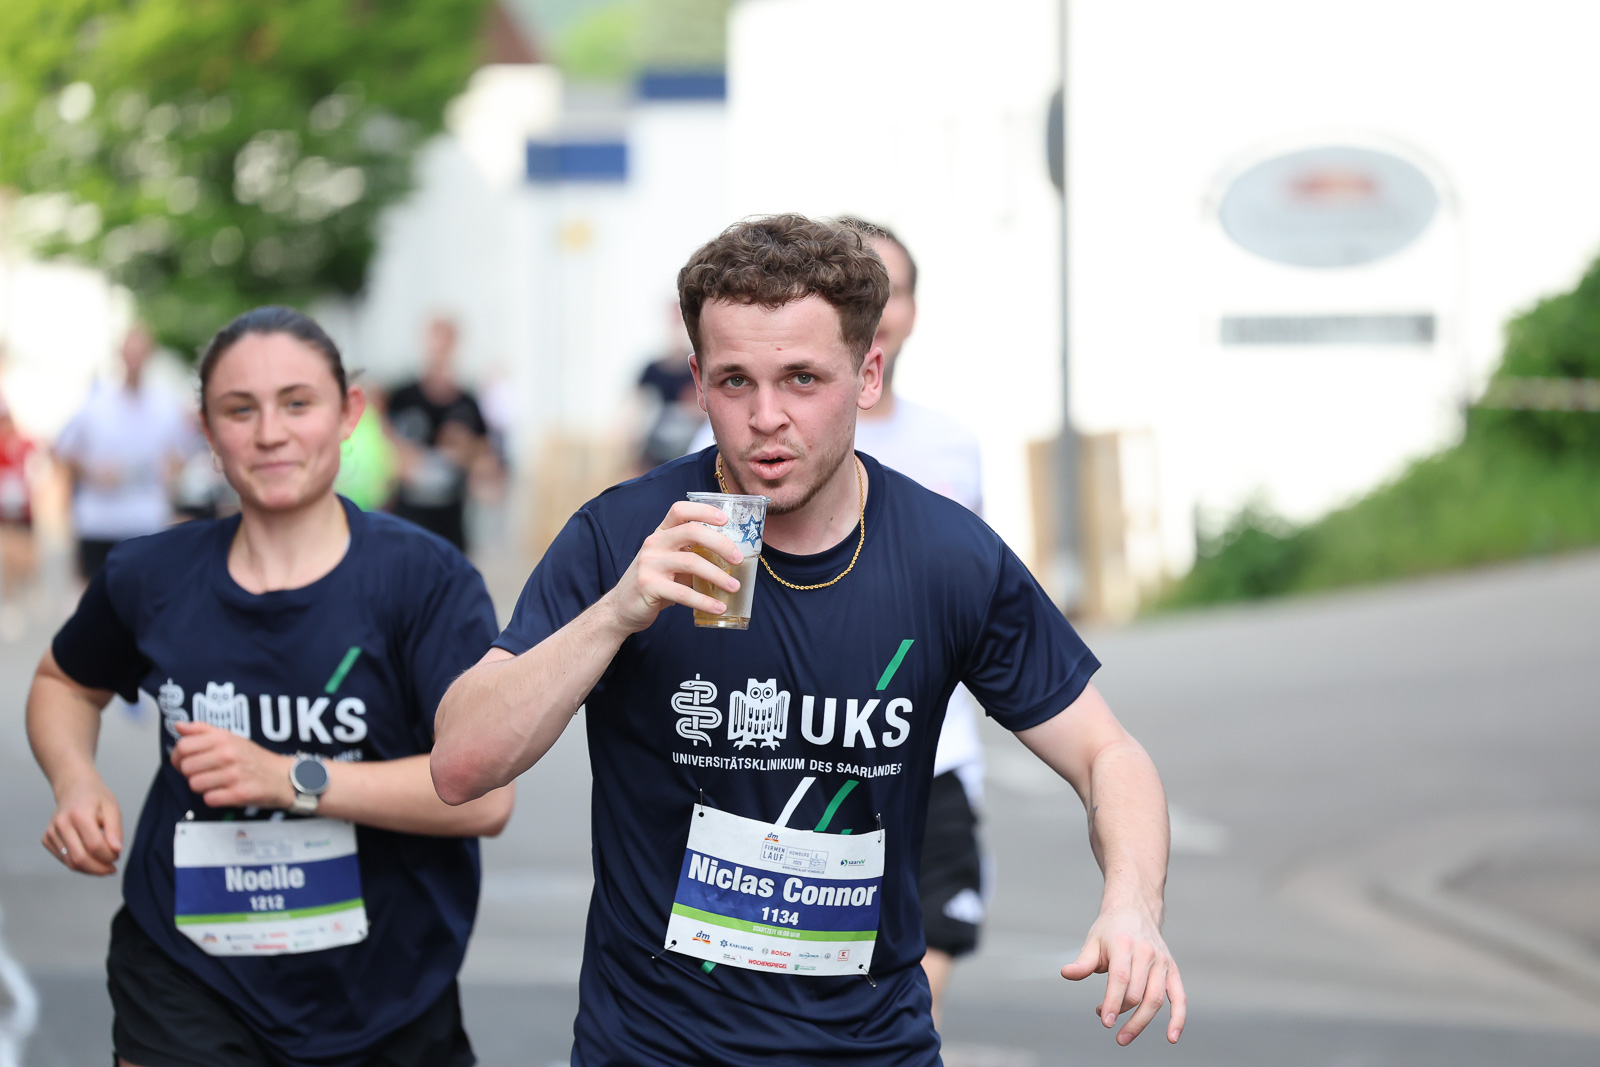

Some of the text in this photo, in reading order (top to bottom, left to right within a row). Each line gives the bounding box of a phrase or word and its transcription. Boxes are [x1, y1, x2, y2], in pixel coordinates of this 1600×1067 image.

[259, 694, 368, 744] UKS
[800, 695, 913, 748] UKS
[672, 751, 902, 778] UNIVERSITÄTSKLINIKUM DES SAARLANDES
[767, 832, 779, 840] dm
[764, 844, 785, 853] FIRMEN
[763, 852, 784, 861] LAUF
[225, 864, 305, 892] Noelle
[688, 853, 877, 906] Niclas Connor
[250, 894, 285, 911] 1212
[761, 906, 799, 925] 1134
[695, 930, 711, 940] dm
[753, 925, 777, 935] STARTZEIT
[729, 943, 754, 951] KARLSBERG
[771, 949, 791, 957] BOSCH
[748, 959, 787, 969] WOCHENSPIEGEL
